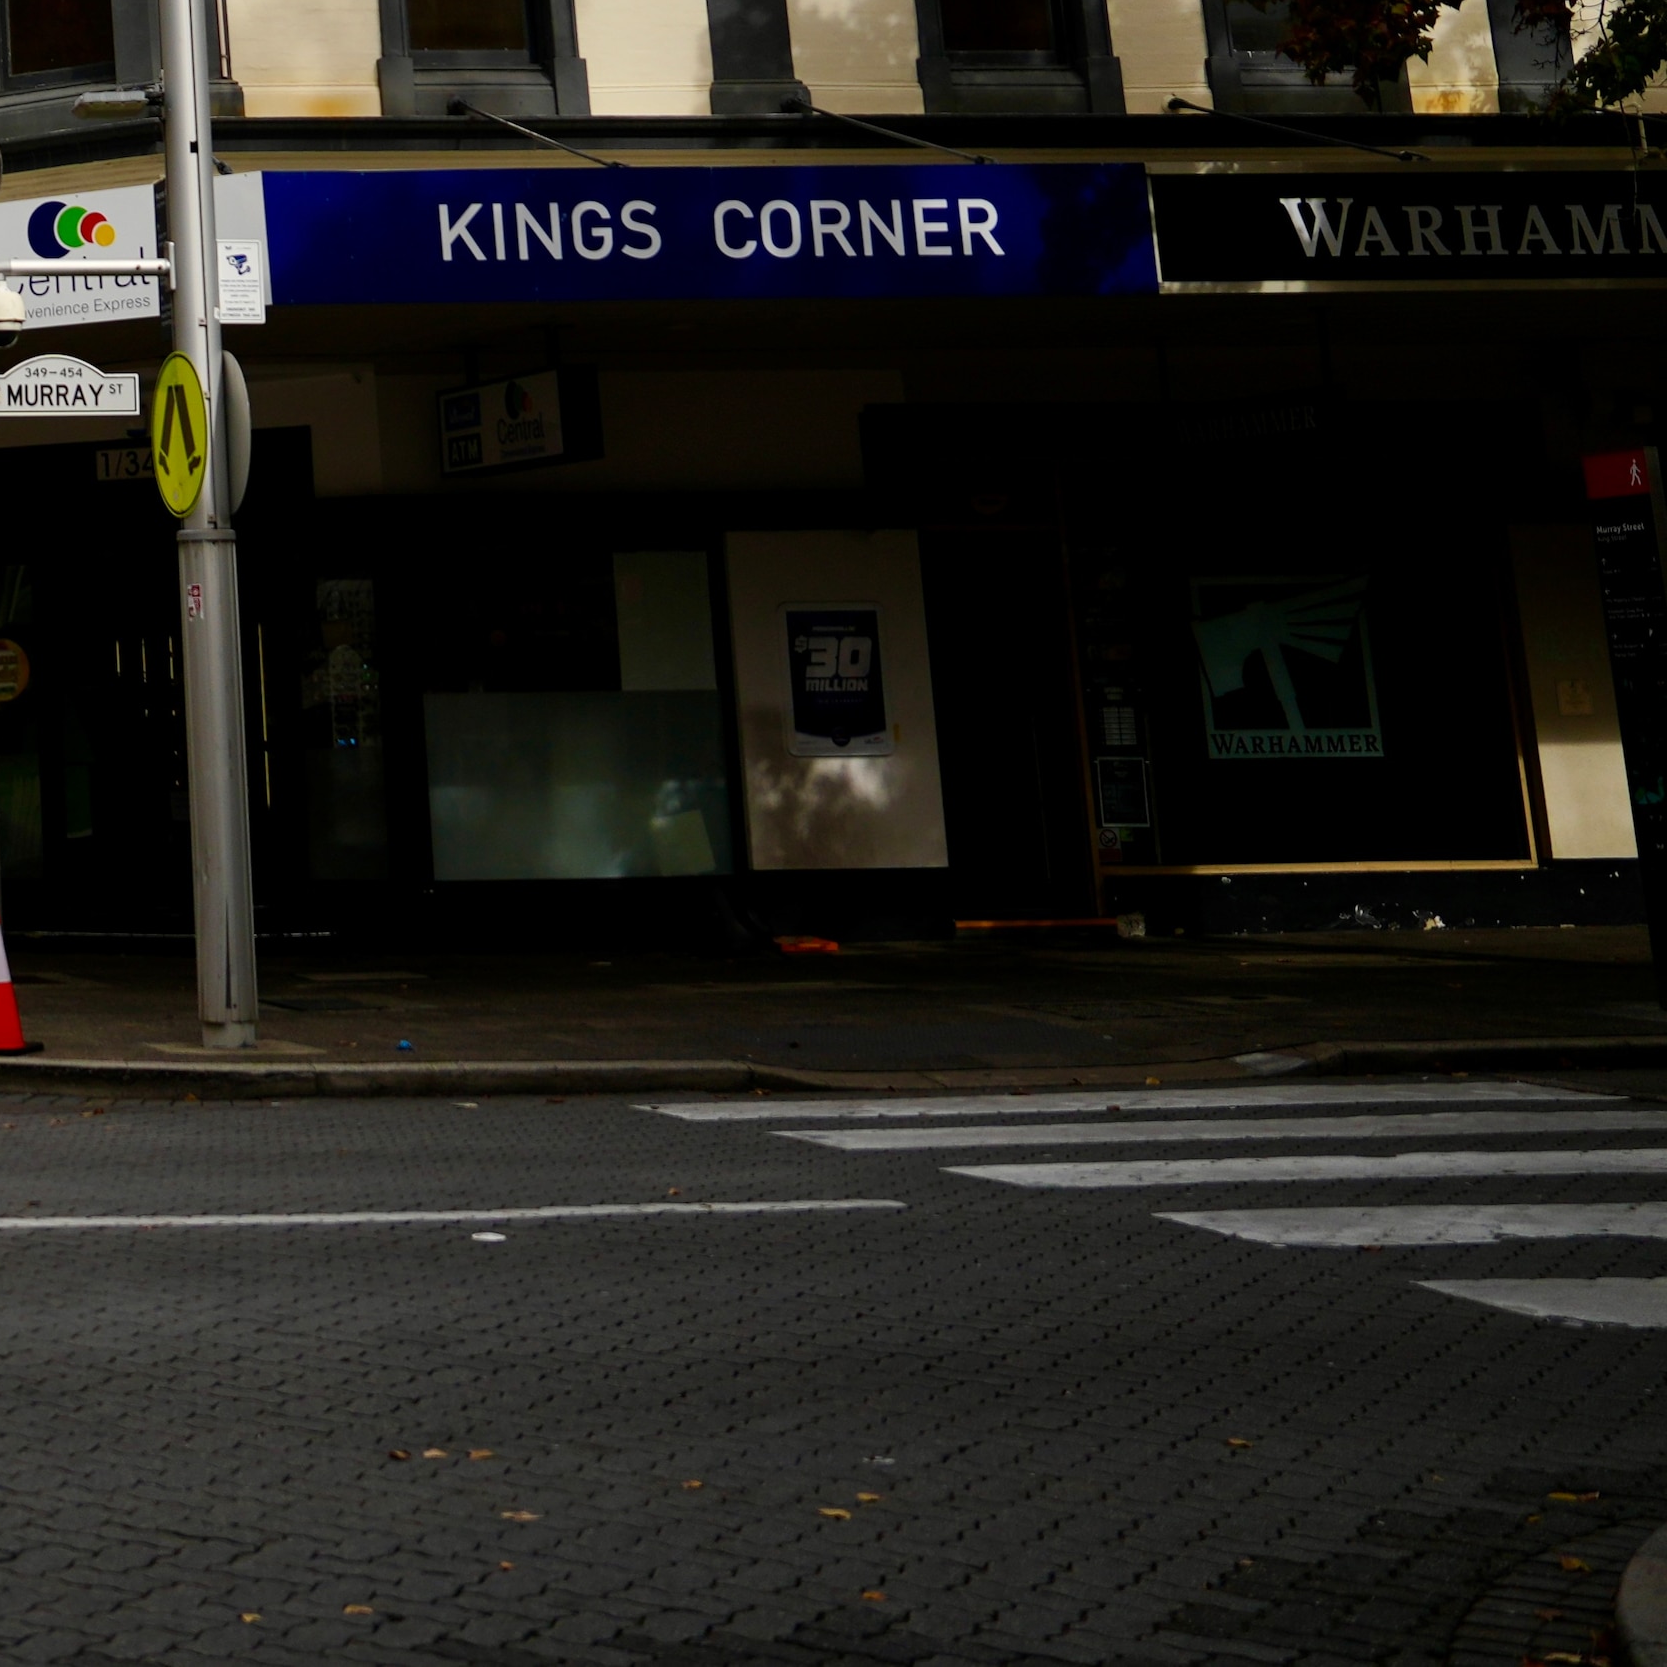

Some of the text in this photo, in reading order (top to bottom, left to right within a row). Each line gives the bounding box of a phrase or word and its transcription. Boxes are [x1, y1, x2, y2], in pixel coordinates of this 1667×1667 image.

[439, 197, 1006, 262] KINGS CORNER
[94, 295, 151, 312] Express
[25, 367, 83, 378] 349-454
[7, 384, 123, 406] MURRAY ST
[497, 412, 545, 444] Central
[450, 438, 479, 463] ATM
[1596, 525, 1622, 535] Murray
[805, 678, 869, 692] MILLION
[1210, 733, 1380, 755] WARHAMMER
